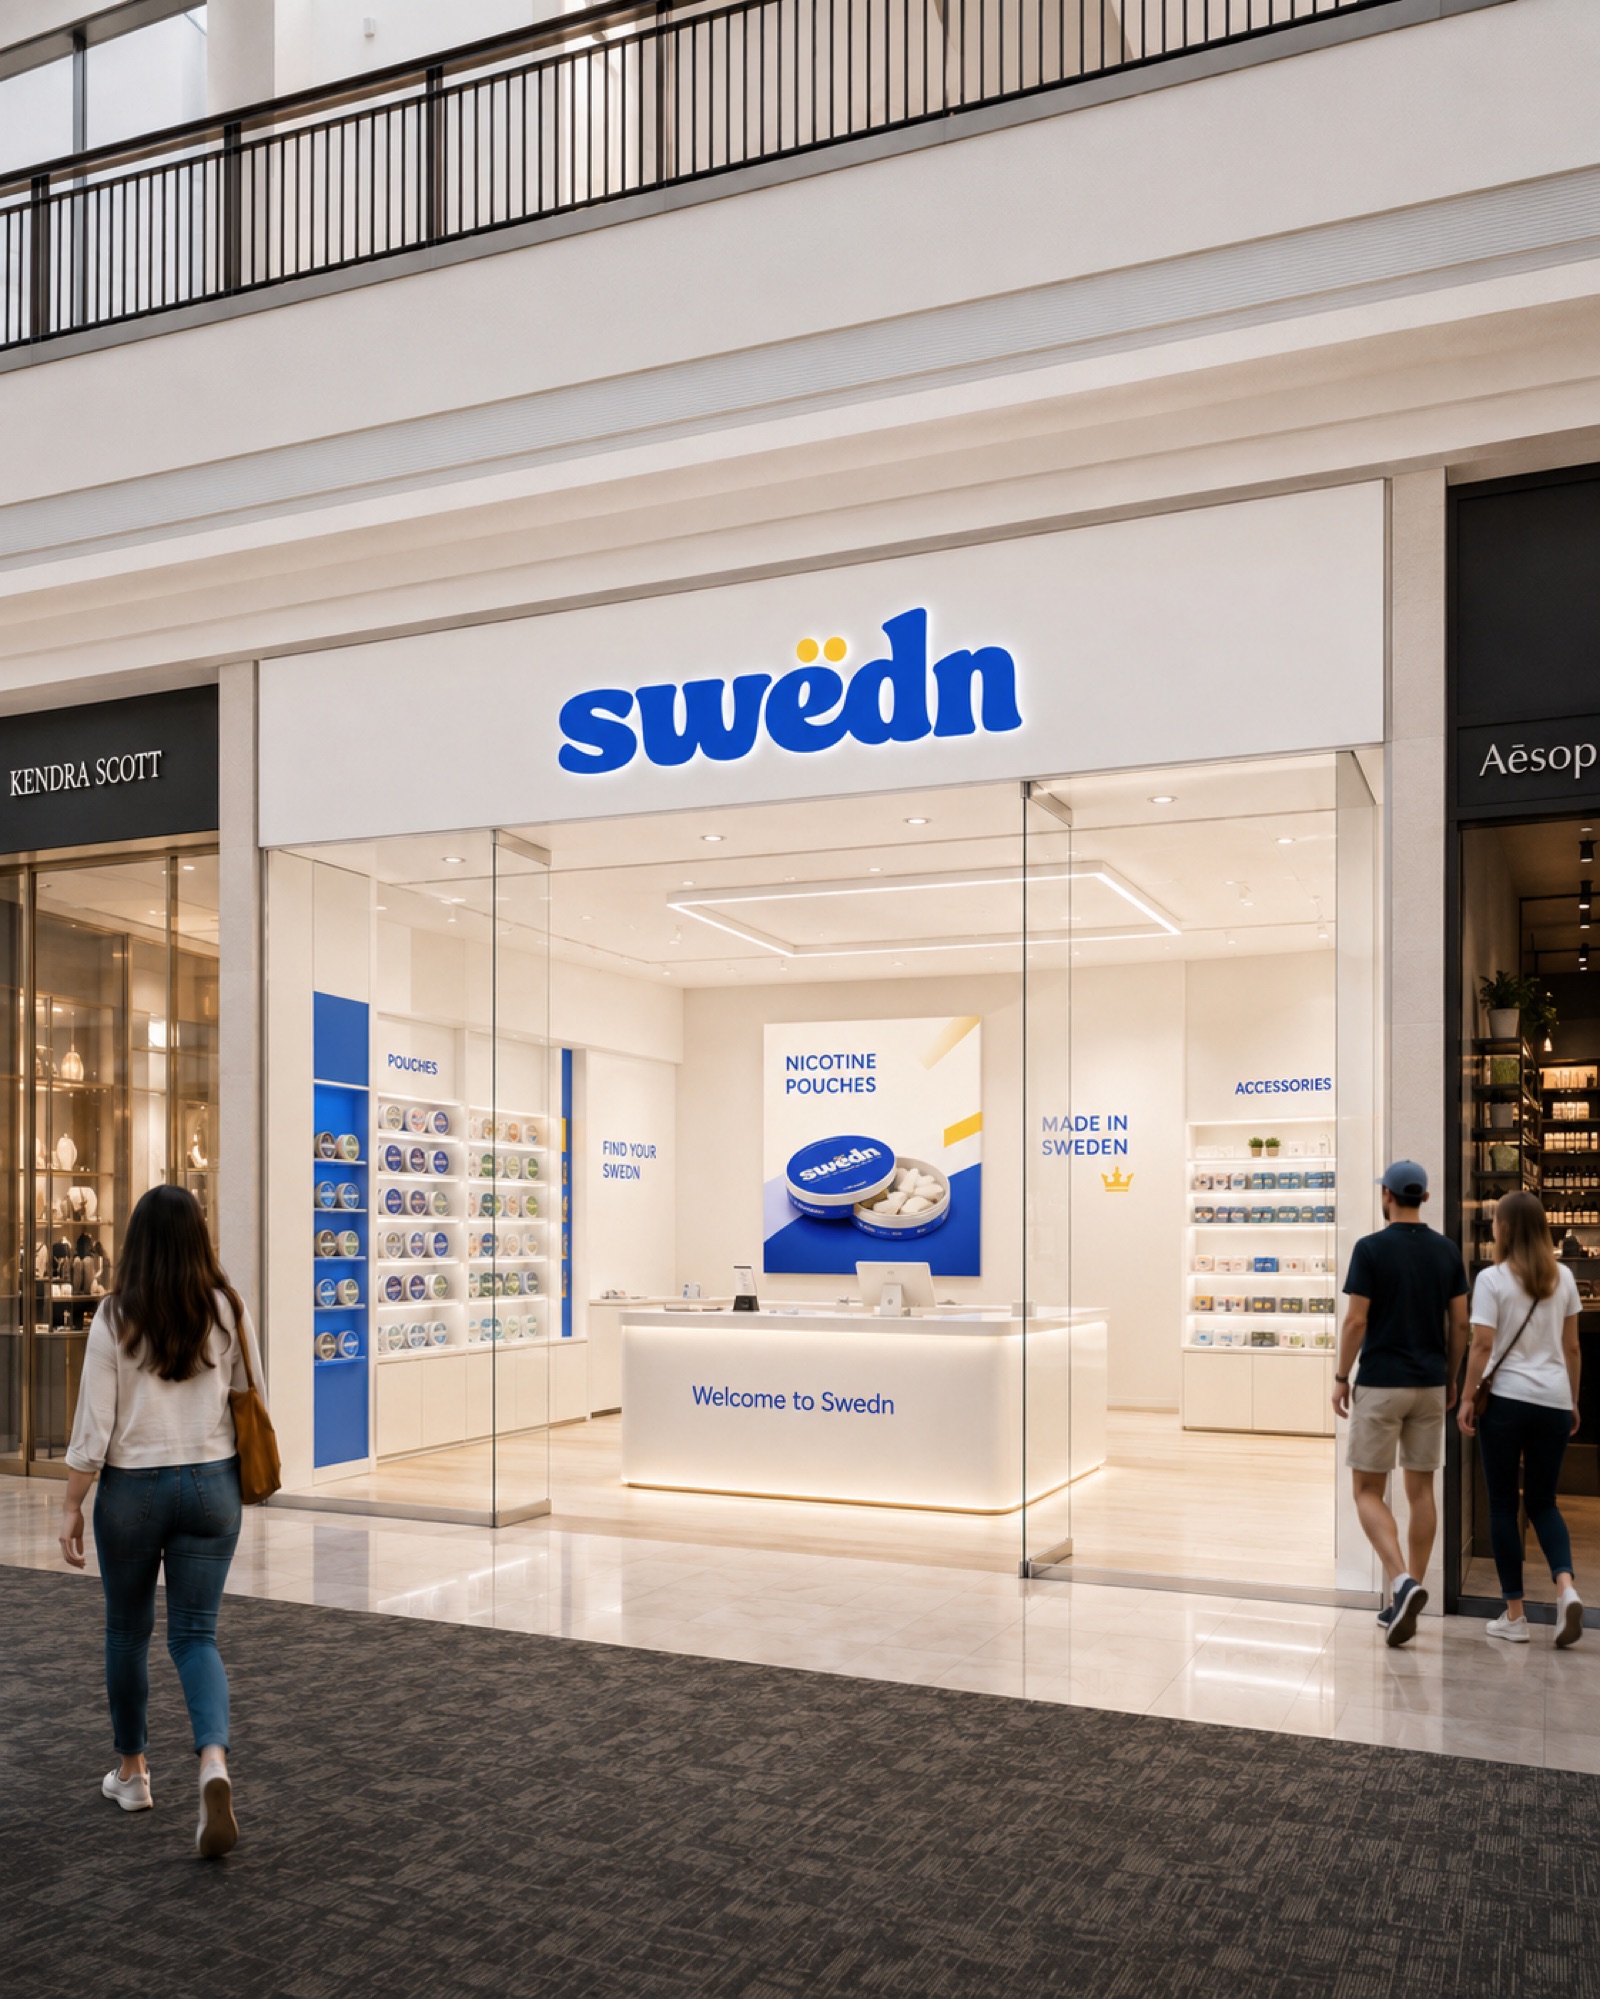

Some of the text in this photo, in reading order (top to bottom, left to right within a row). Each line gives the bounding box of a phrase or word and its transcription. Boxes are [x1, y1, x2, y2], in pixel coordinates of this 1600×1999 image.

[558, 607, 1022, 774] swëdn
[1479, 743, 1598, 780] Aēsop
[10, 750, 162, 796] KENDRA SCOTT
[388, 1053, 438, 1075] POUCHES
[786, 1053, 877, 1072] NICOTINE
[786, 1077, 877, 1095] POUCHES
[1235, 1077, 1332, 1095] ACCESSORIES
[1042, 1115, 1128, 1132] MADE IN
[603, 1140, 657, 1159] FIND YOUR
[1042, 1139, 1128, 1156] SWEDEN
[603, 1163, 640, 1180] SWEDN
[692, 1385, 895, 1415] Welcome to Swedn
